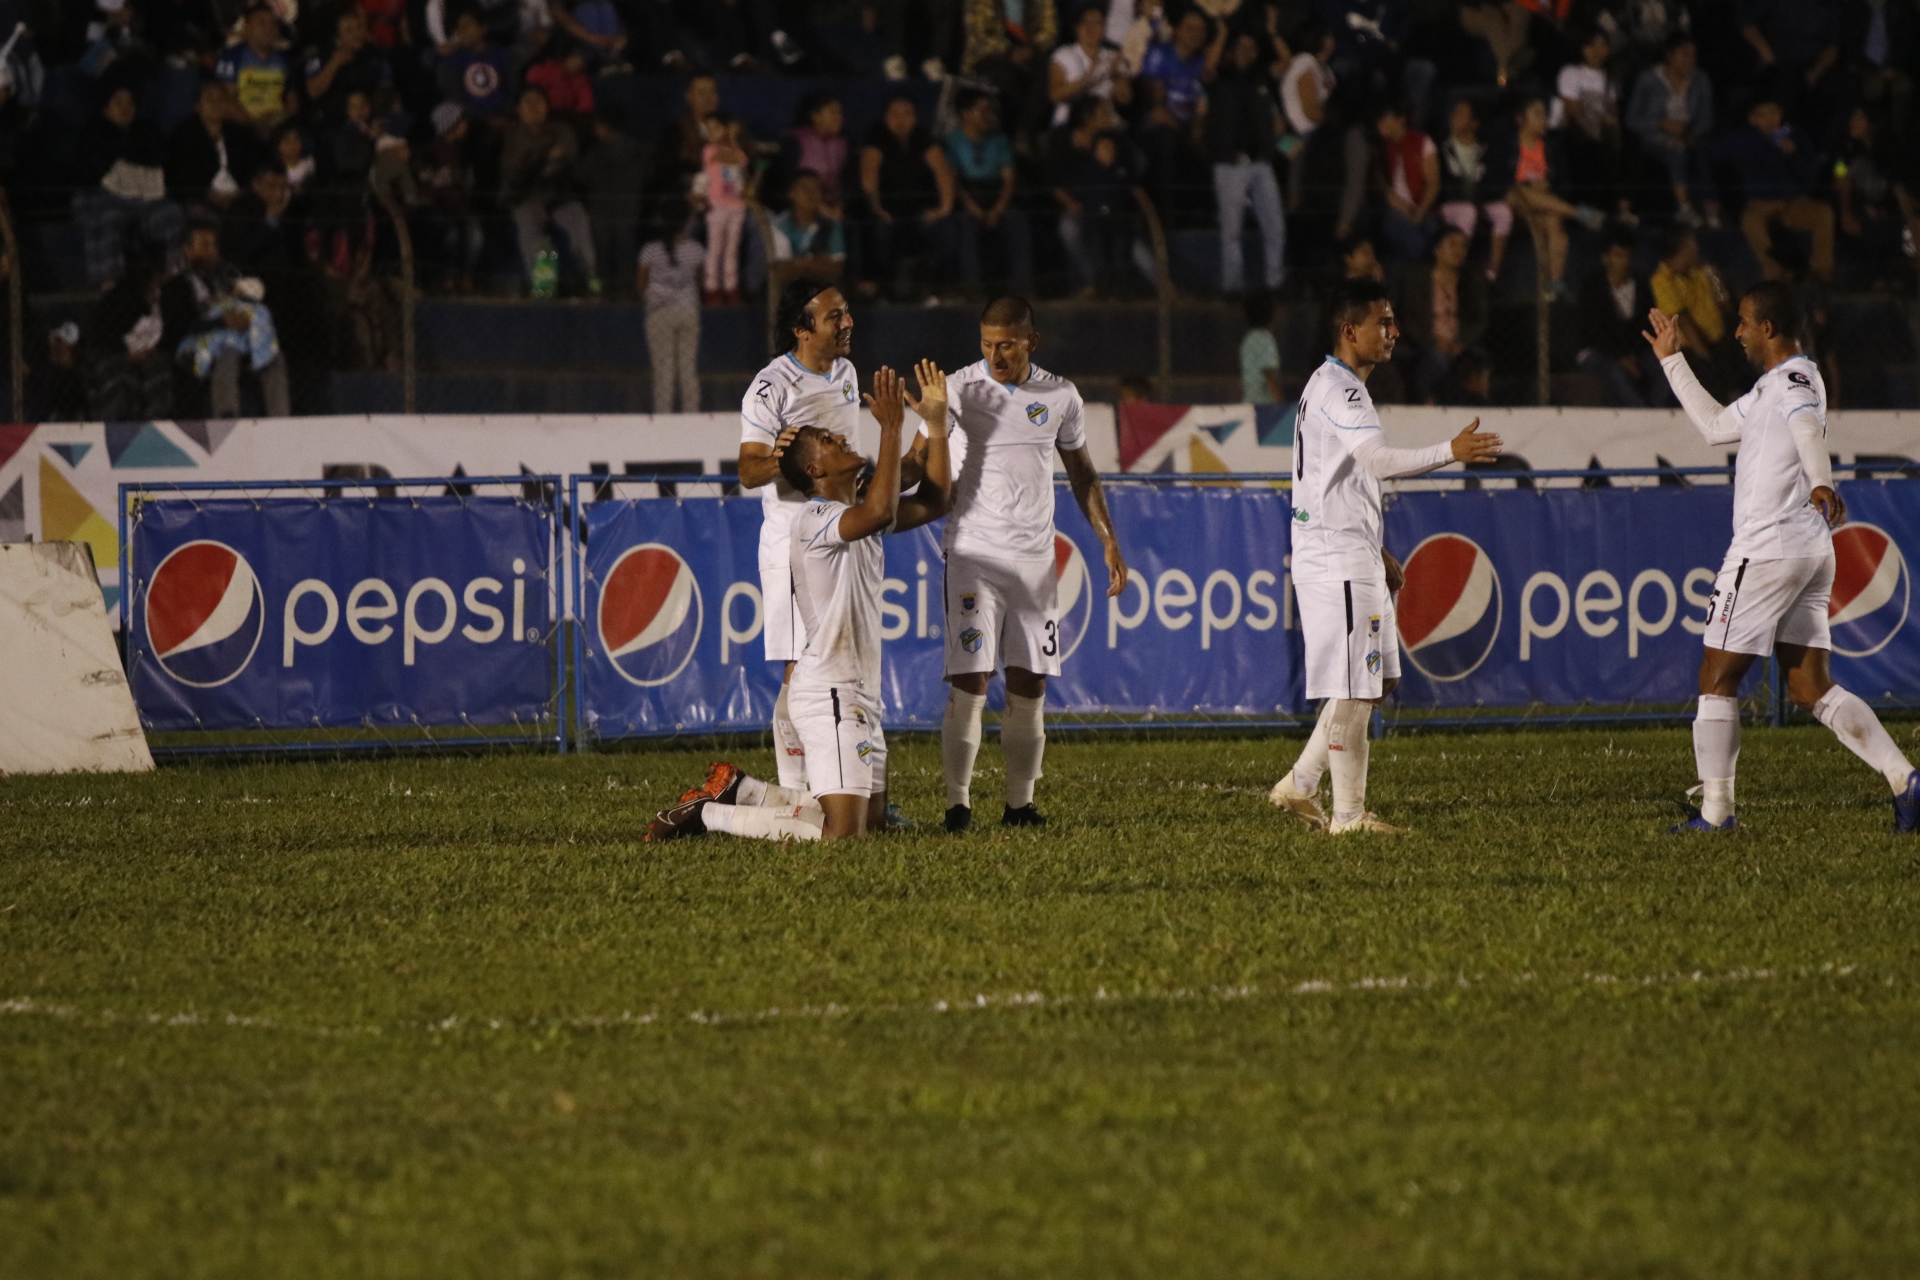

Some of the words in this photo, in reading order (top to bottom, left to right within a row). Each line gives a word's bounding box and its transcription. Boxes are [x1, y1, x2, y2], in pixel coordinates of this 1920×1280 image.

[1344, 388, 1361, 403] Z
[283, 558, 526, 667] pepsi
[721, 560, 928, 665] psi
[1042, 619, 1060, 657] 3
[1107, 554, 1293, 649] pepsi
[1520, 567, 1717, 661] peps
